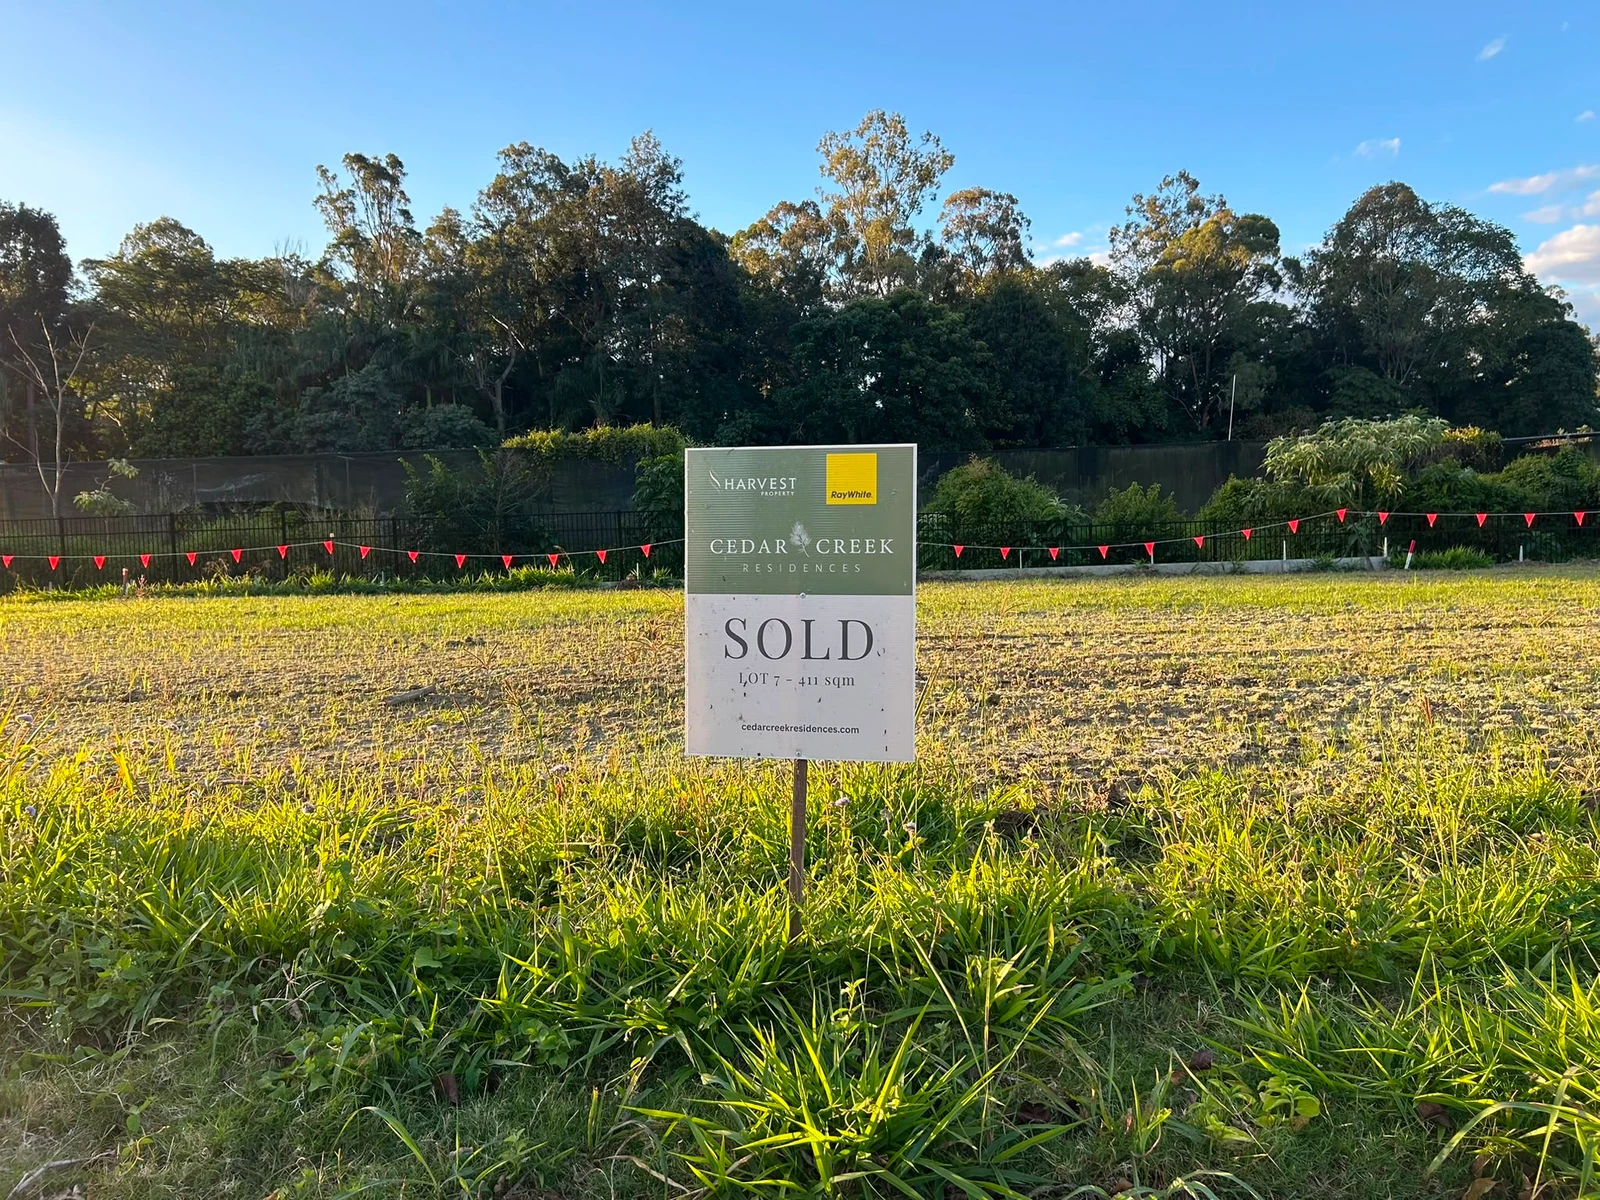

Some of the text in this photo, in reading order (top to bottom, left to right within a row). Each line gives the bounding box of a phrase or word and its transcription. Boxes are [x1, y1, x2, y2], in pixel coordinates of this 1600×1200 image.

[724, 477, 797, 490] HARVEST
[710, 538, 894, 555] CEDAR CREEK
[743, 563, 861, 573] RESIDENCES
[724, 617, 874, 661] SOLD
[739, 672, 769, 684] LOT
[773, 675, 780, 687] 7
[798, 675, 819, 686] 411
[824, 676, 856, 688] sqm
[741, 723, 860, 734] cedarcreekresidences.com
